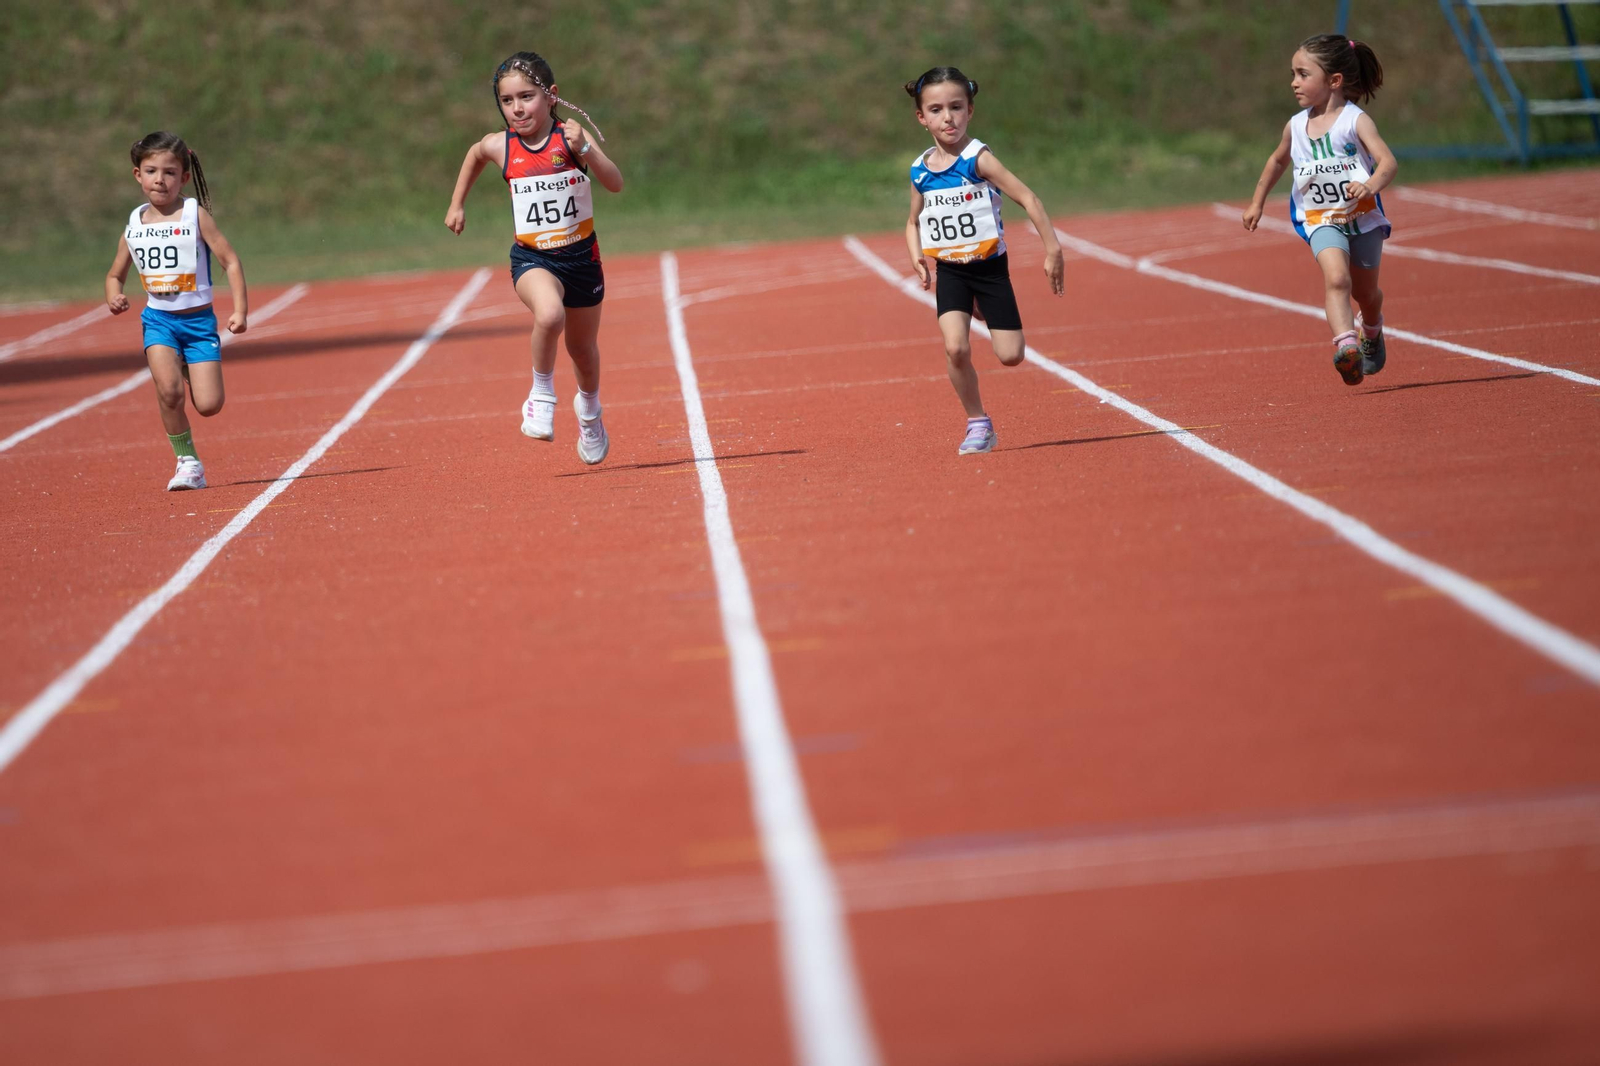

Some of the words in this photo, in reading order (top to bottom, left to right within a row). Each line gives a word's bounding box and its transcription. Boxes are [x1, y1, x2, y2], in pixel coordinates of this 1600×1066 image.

[1299, 167, 1312, 176] La
[514, 182, 532, 194] La
[536, 175, 585, 192] Región
[526, 196, 579, 226] 454
[127, 229, 142, 239] La
[146, 226, 190, 239] Región
[927, 213, 977, 241] 368
[536, 234, 582, 250] telemiño
